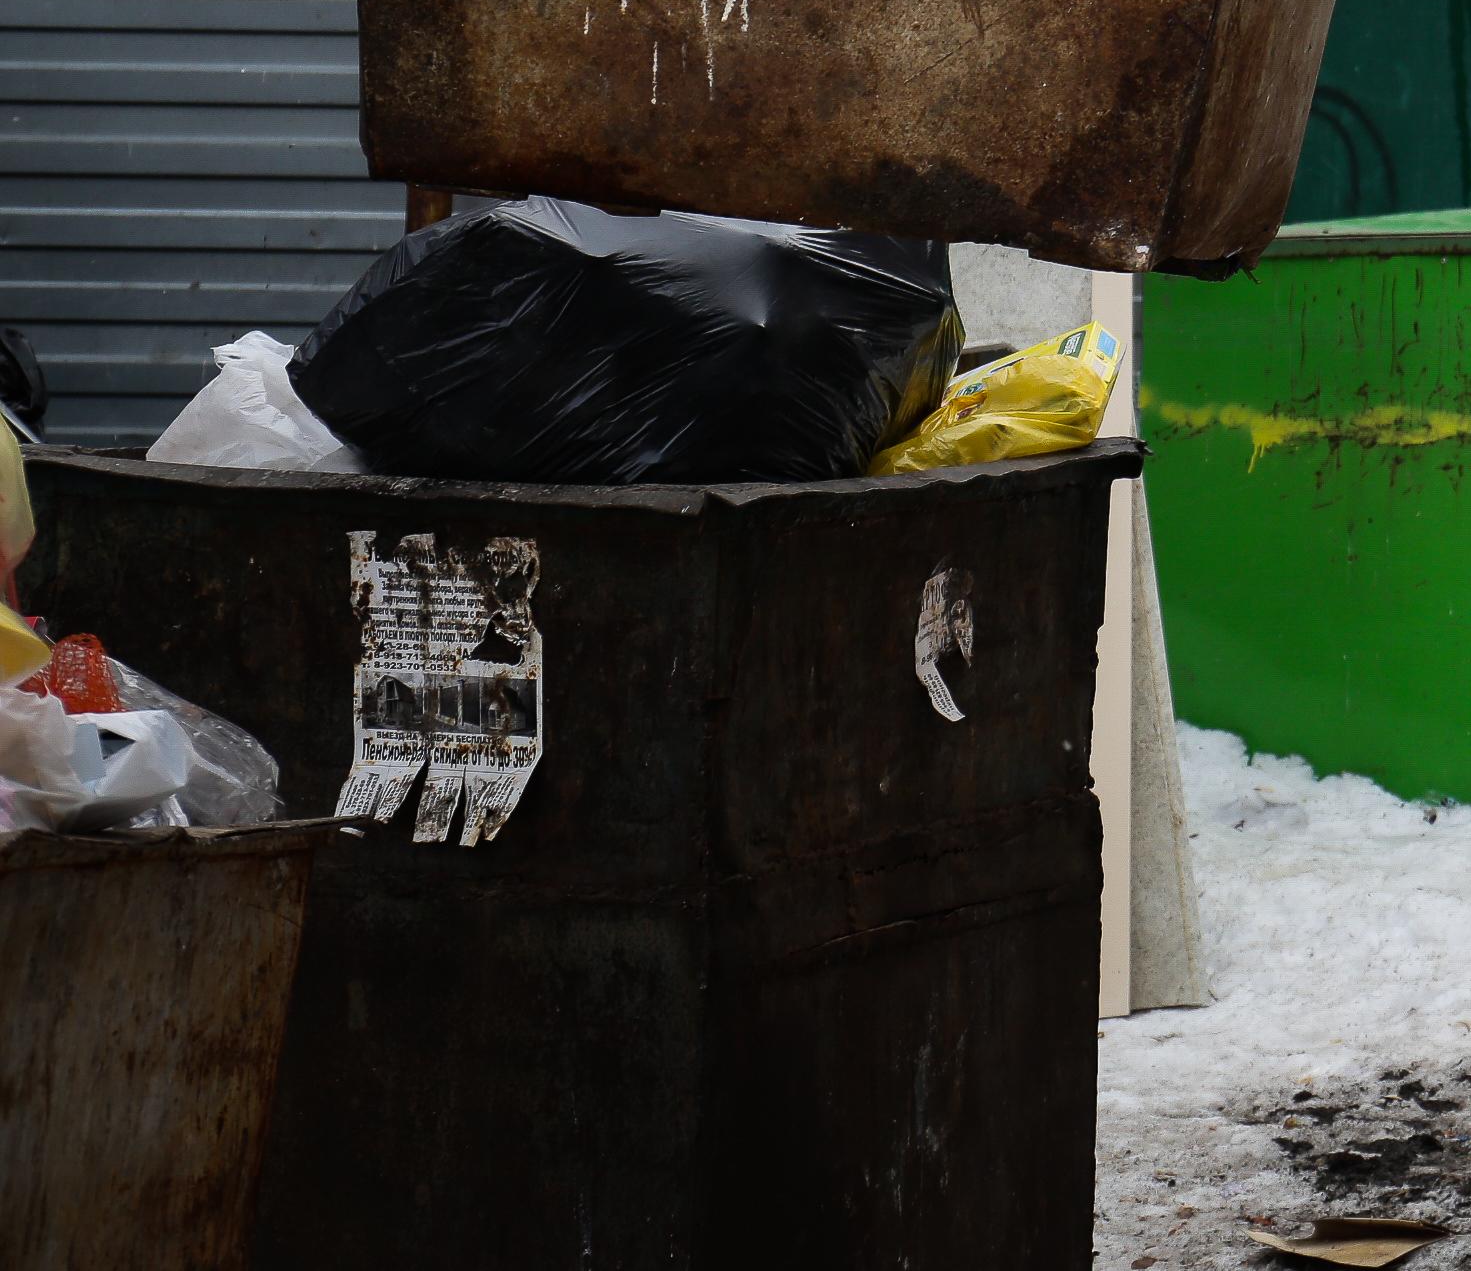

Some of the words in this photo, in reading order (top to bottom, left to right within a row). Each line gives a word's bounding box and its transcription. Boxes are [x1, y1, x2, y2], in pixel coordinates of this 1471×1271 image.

[363, 628, 398, 640] РАБОТАЕМ
[456, 736, 501, 746] БЕСПЛАТ
[433, 746, 469, 769] скидка
[471, 750, 482, 766] от
[485, 745, 496, 767] 15
[496, 749, 511, 771] до
